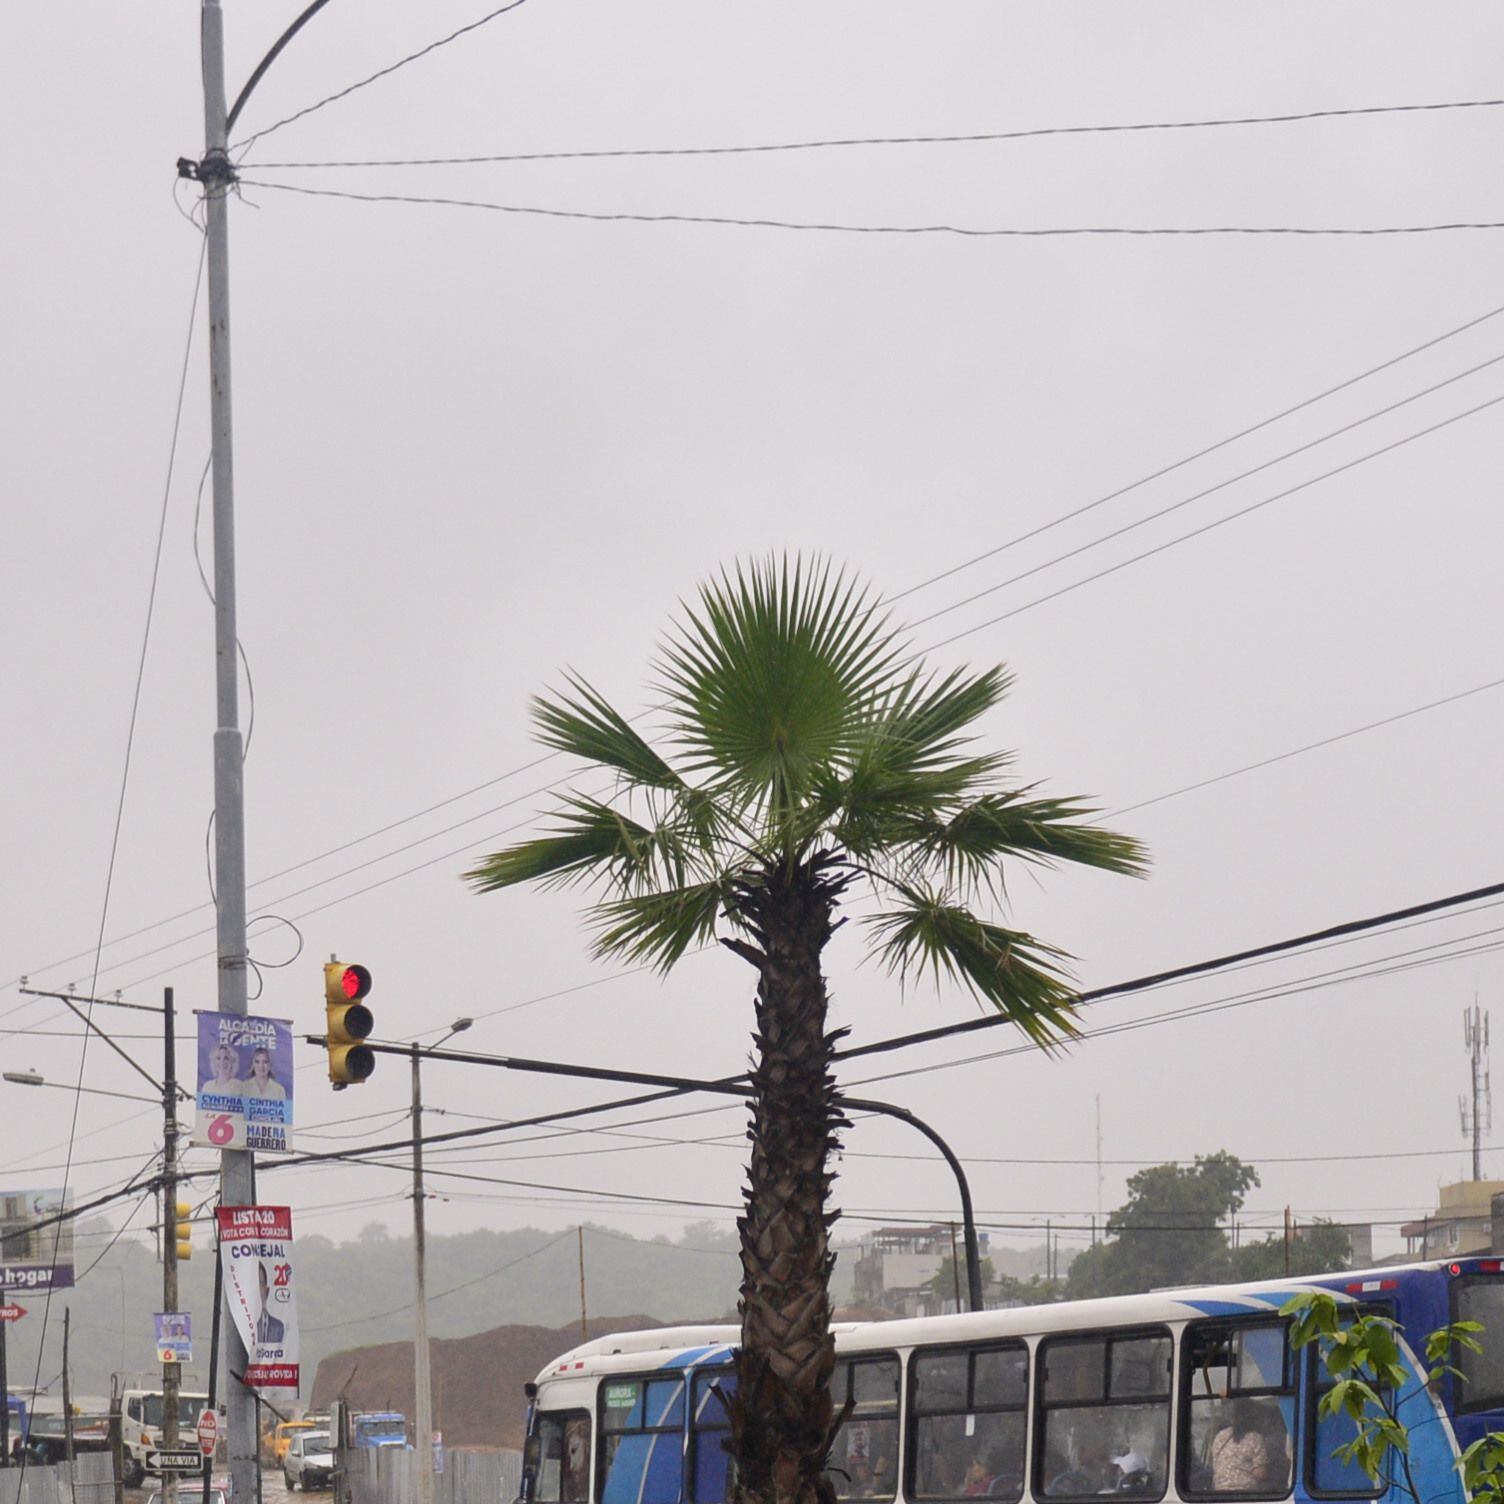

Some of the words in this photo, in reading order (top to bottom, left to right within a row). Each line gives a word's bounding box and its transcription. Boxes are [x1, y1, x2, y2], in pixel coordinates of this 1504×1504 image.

[201, 1094, 243, 1105] CYNTHIA
[207, 1114, 234, 1145] 6
[247, 1125, 286, 1138] MADERA
[246, 1137, 286, 1151] GUERRERO
[233, 1210, 262, 1225] LISTA
[262, 1210, 275, 1224] 20
[201, 1419, 216, 1428] NO
[161, 1455, 178, 1465] UNA
